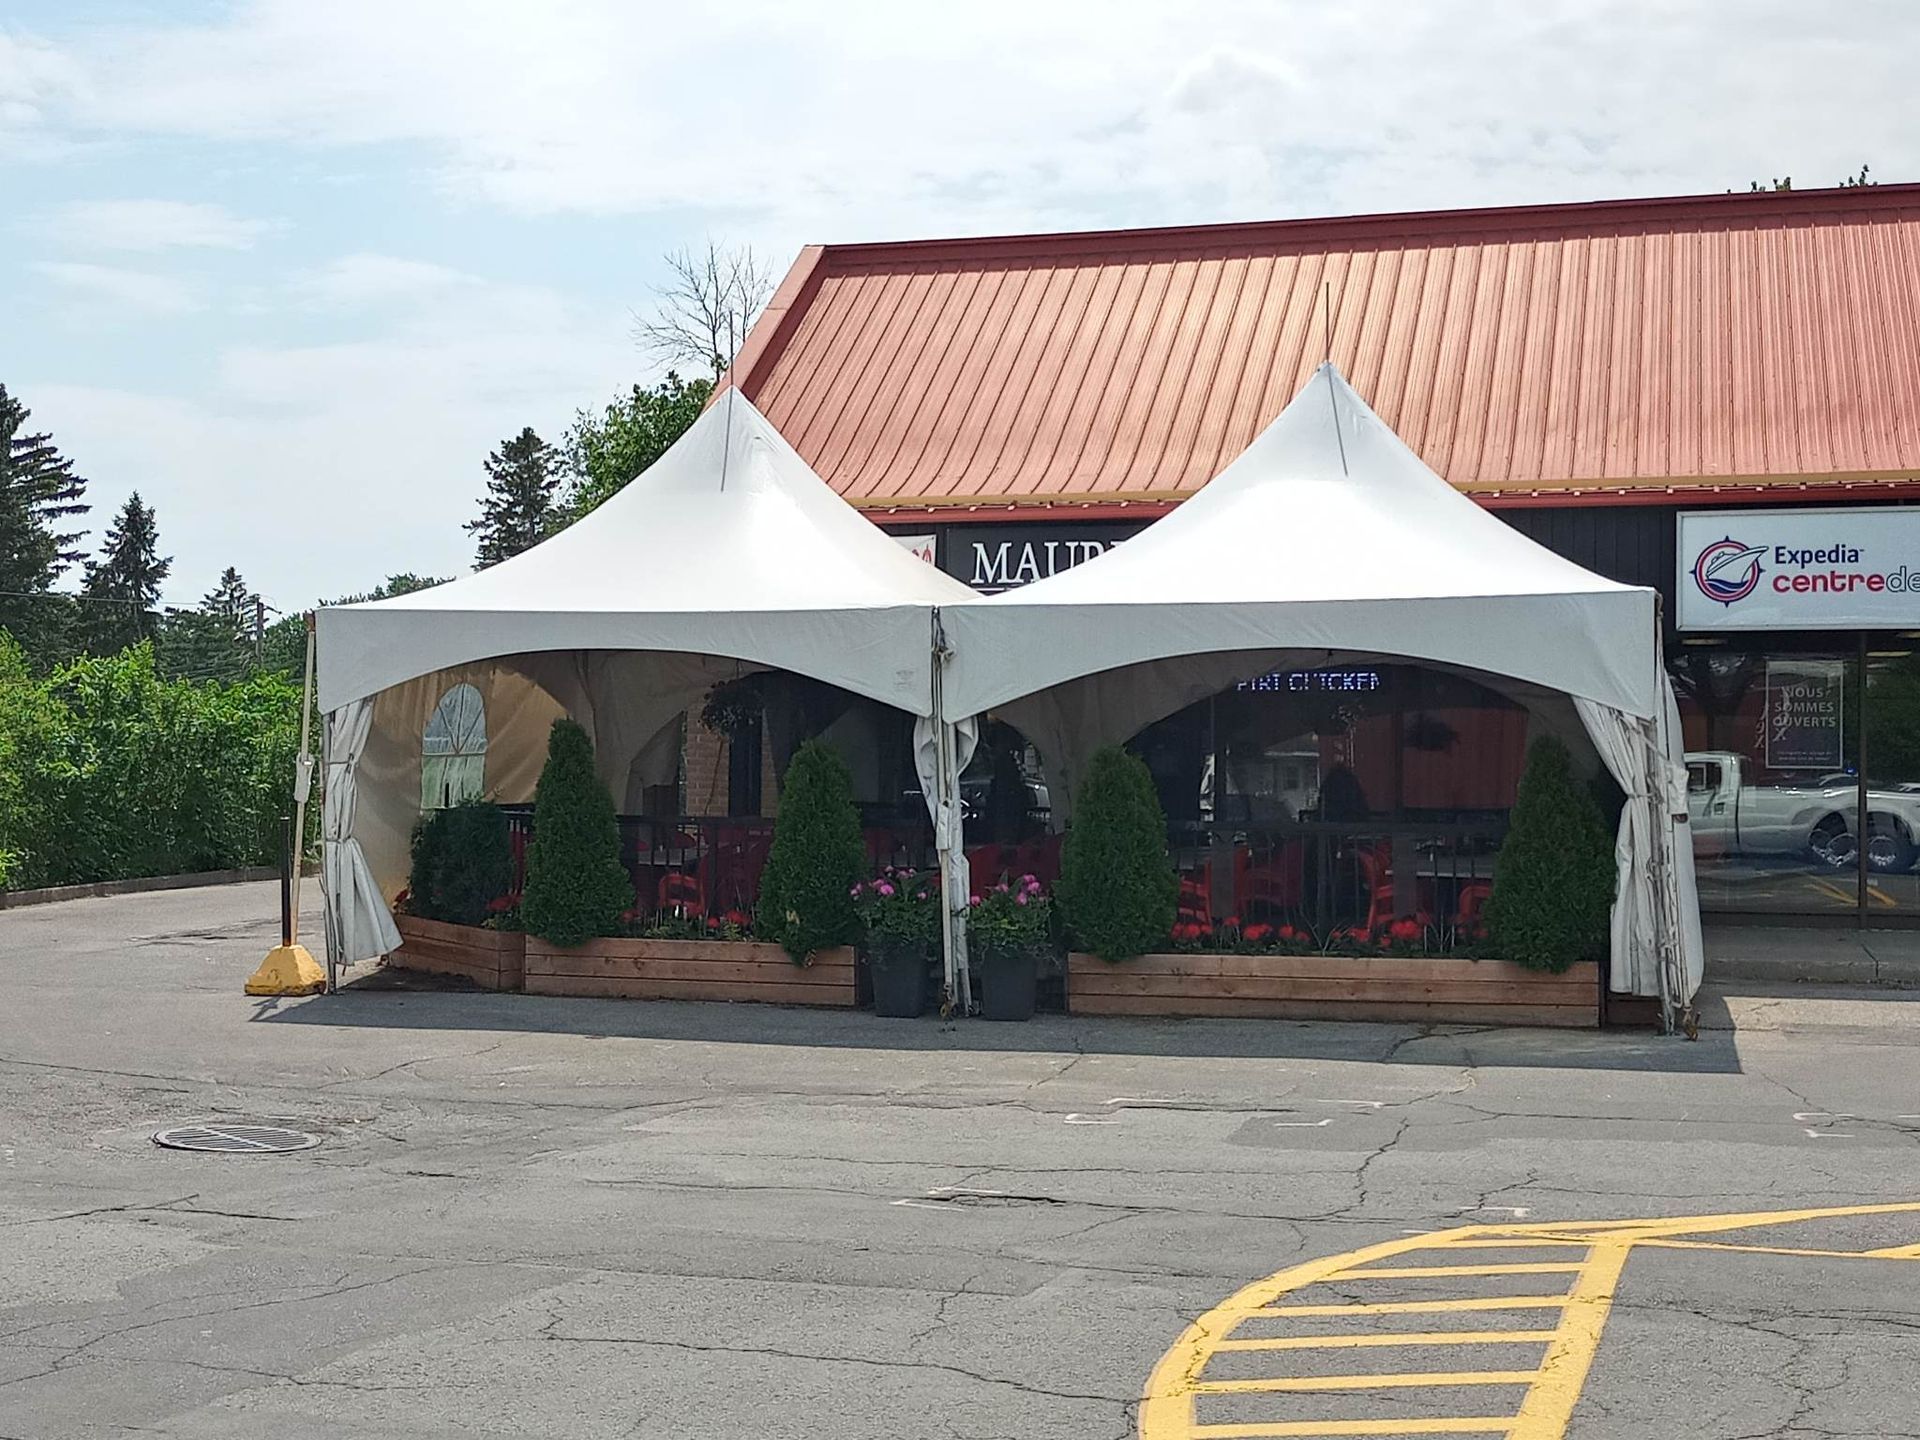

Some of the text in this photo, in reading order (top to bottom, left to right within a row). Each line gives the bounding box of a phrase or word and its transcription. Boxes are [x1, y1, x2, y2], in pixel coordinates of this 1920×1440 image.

[1774, 544, 1859, 569] Expedia
[1783, 687, 1823, 698] NOUS
[1775, 702, 1833, 712] SOMMES
[1772, 716, 1836, 727] OUVERTS
